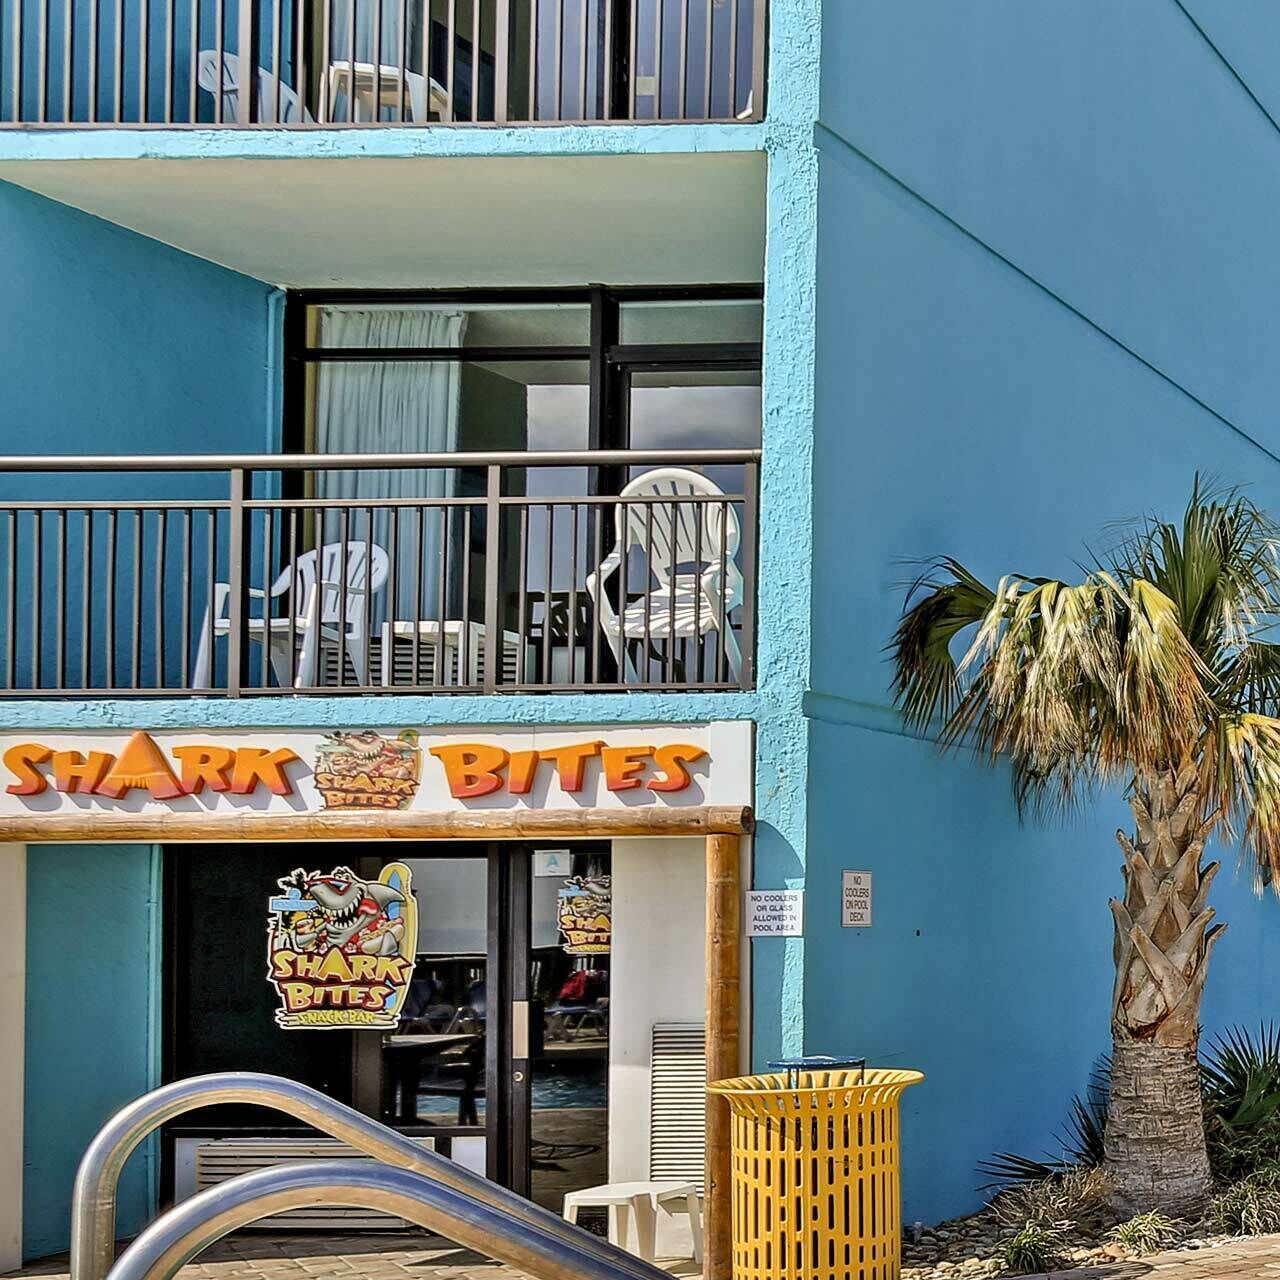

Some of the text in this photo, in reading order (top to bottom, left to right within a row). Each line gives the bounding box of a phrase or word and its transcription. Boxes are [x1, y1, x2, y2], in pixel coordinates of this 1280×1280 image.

[3, 731, 710, 799] SHARK BITES
[316, 772, 418, 795] SHARK
[326, 791, 401, 808] BITES
[854, 875, 862, 885] NO
[845, 887, 869, 897] COOLERS
[846, 900, 868, 910] ON POOL
[850, 912, 864, 922] DECK
[273, 948, 408, 983] SHARK
[282, 982, 391, 1013] BITES
[298, 1010, 376, 1024] SNACK BAR
